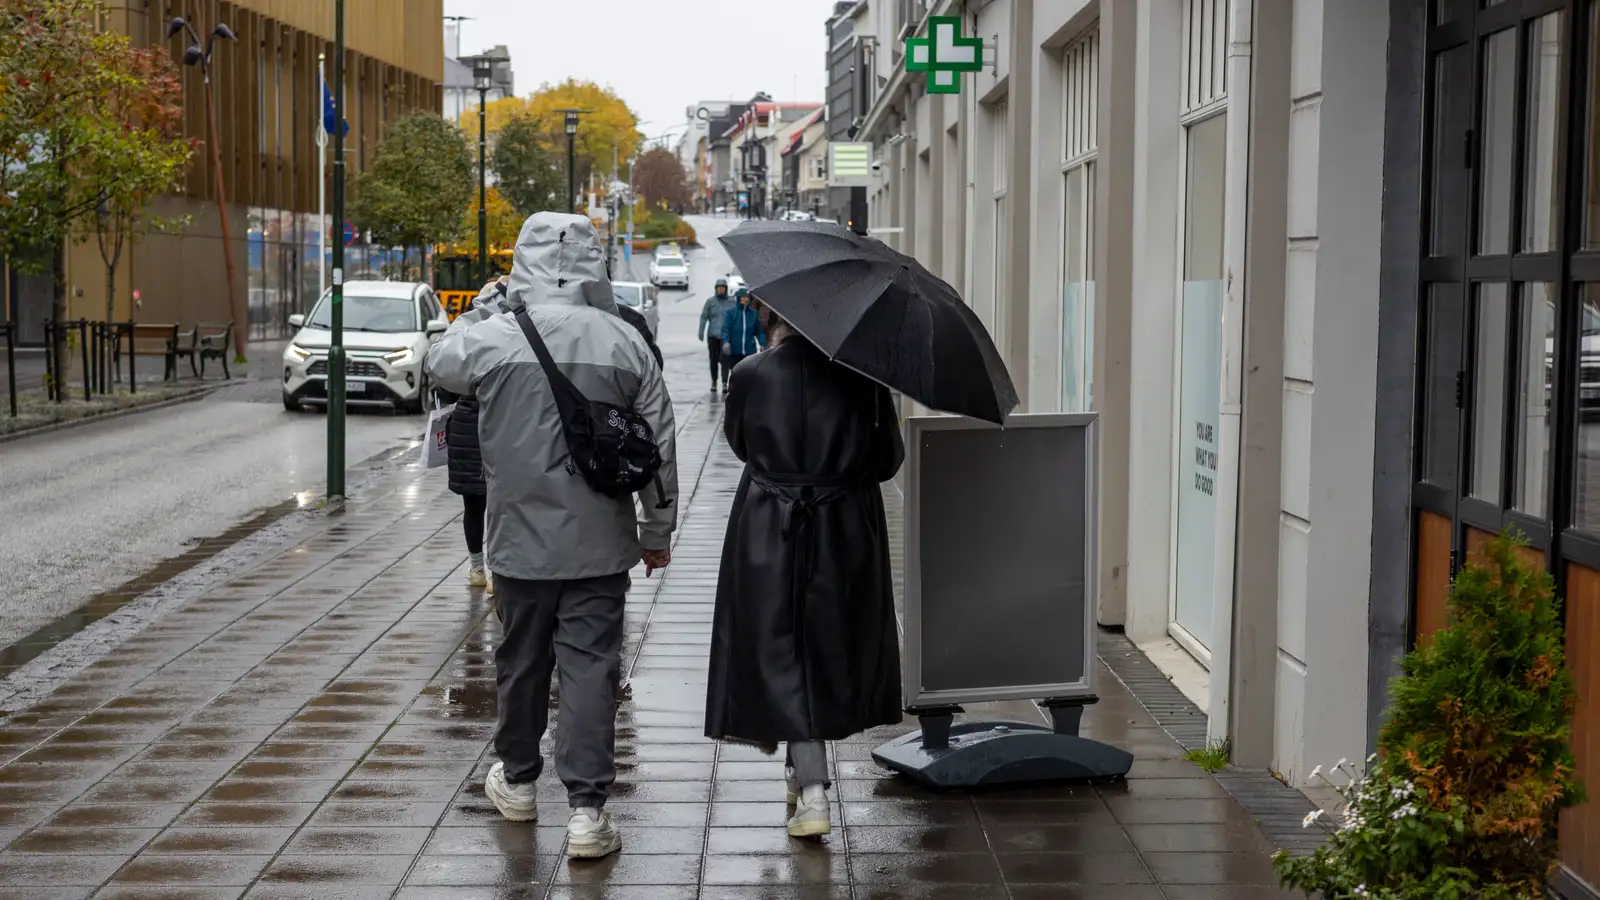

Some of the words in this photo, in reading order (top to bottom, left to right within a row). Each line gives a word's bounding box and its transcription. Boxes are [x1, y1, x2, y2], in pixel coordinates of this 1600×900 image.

[1204, 423, 1213, 443] ARE
[1196, 446, 1207, 468] WHAT
[1207, 450, 1217, 471] YOU
[1195, 472, 1201, 490] DO
[1201, 474, 1213, 496] GOOD
